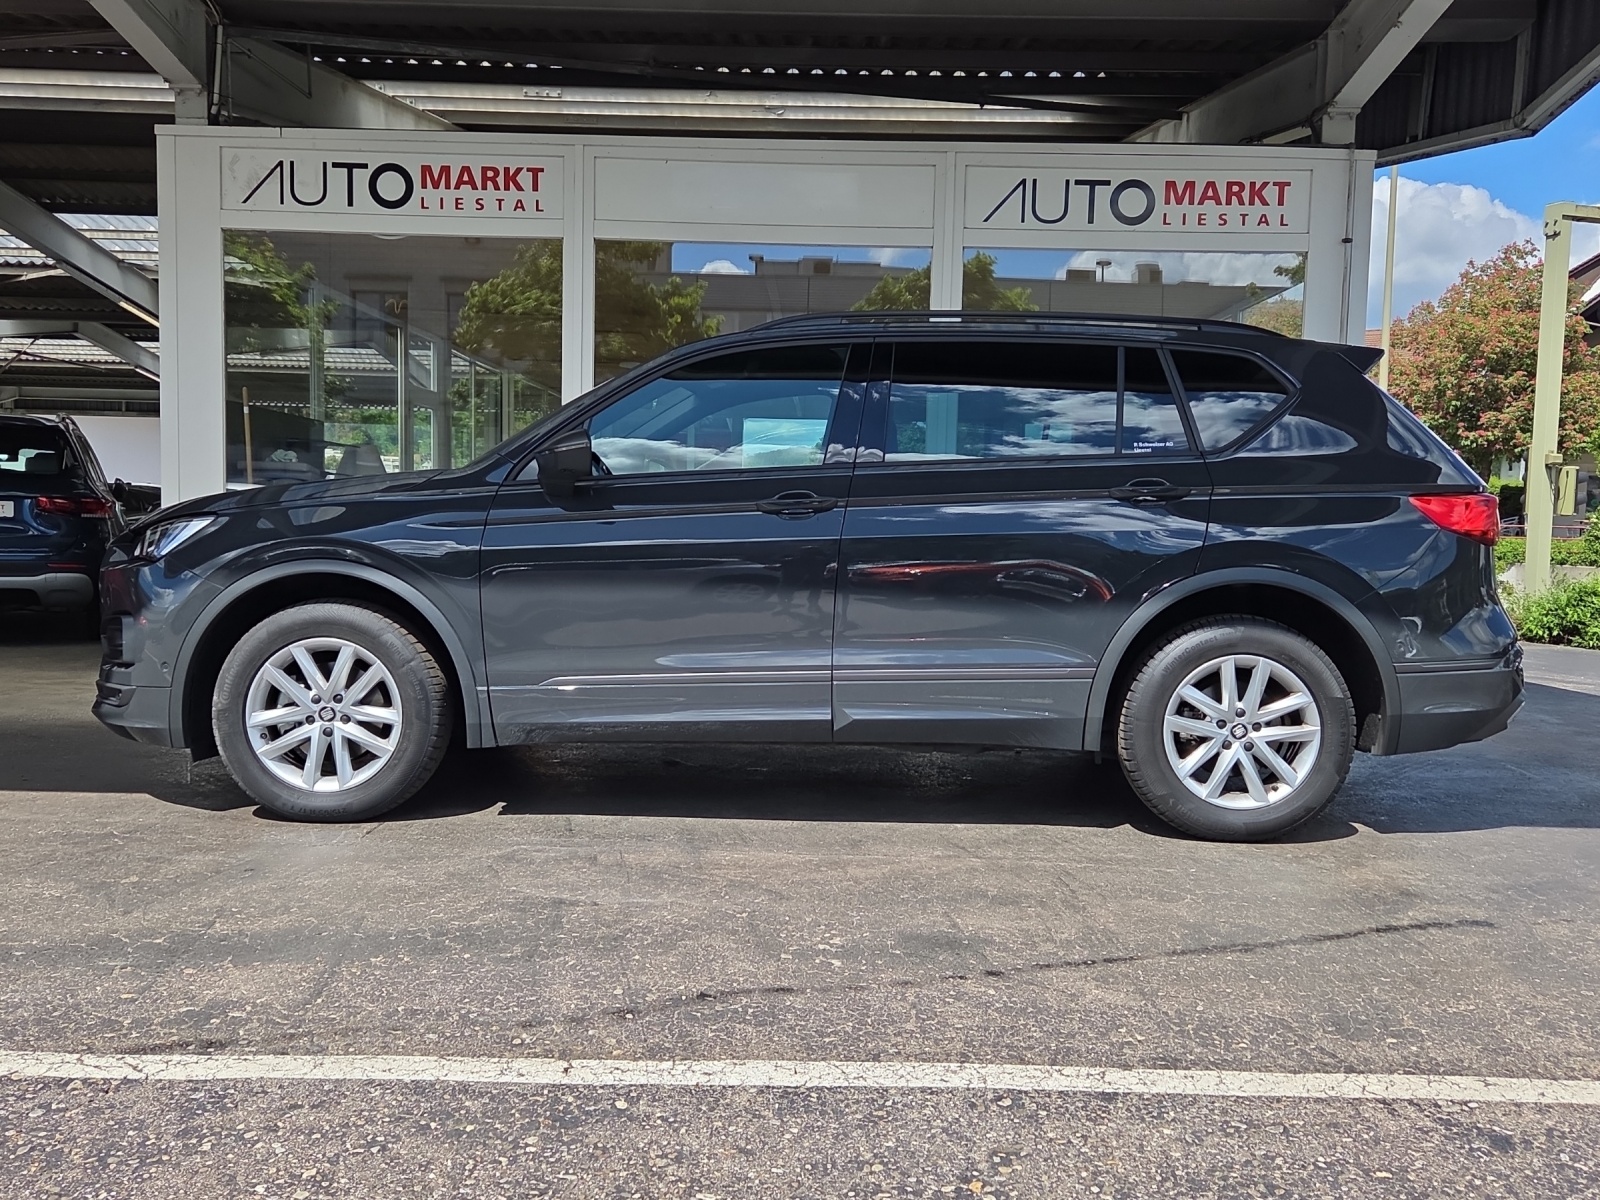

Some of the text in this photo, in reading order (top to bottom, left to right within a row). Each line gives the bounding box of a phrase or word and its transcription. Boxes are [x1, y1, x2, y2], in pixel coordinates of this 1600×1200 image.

[241, 160, 545, 209] AUTO MARKT
[420, 196, 544, 212] LIESTAL
[982, 178, 1292, 226] AUTO MARKT
[1162, 212, 1289, 227] LIESTAL
[219, 640, 260, 704] Continen
